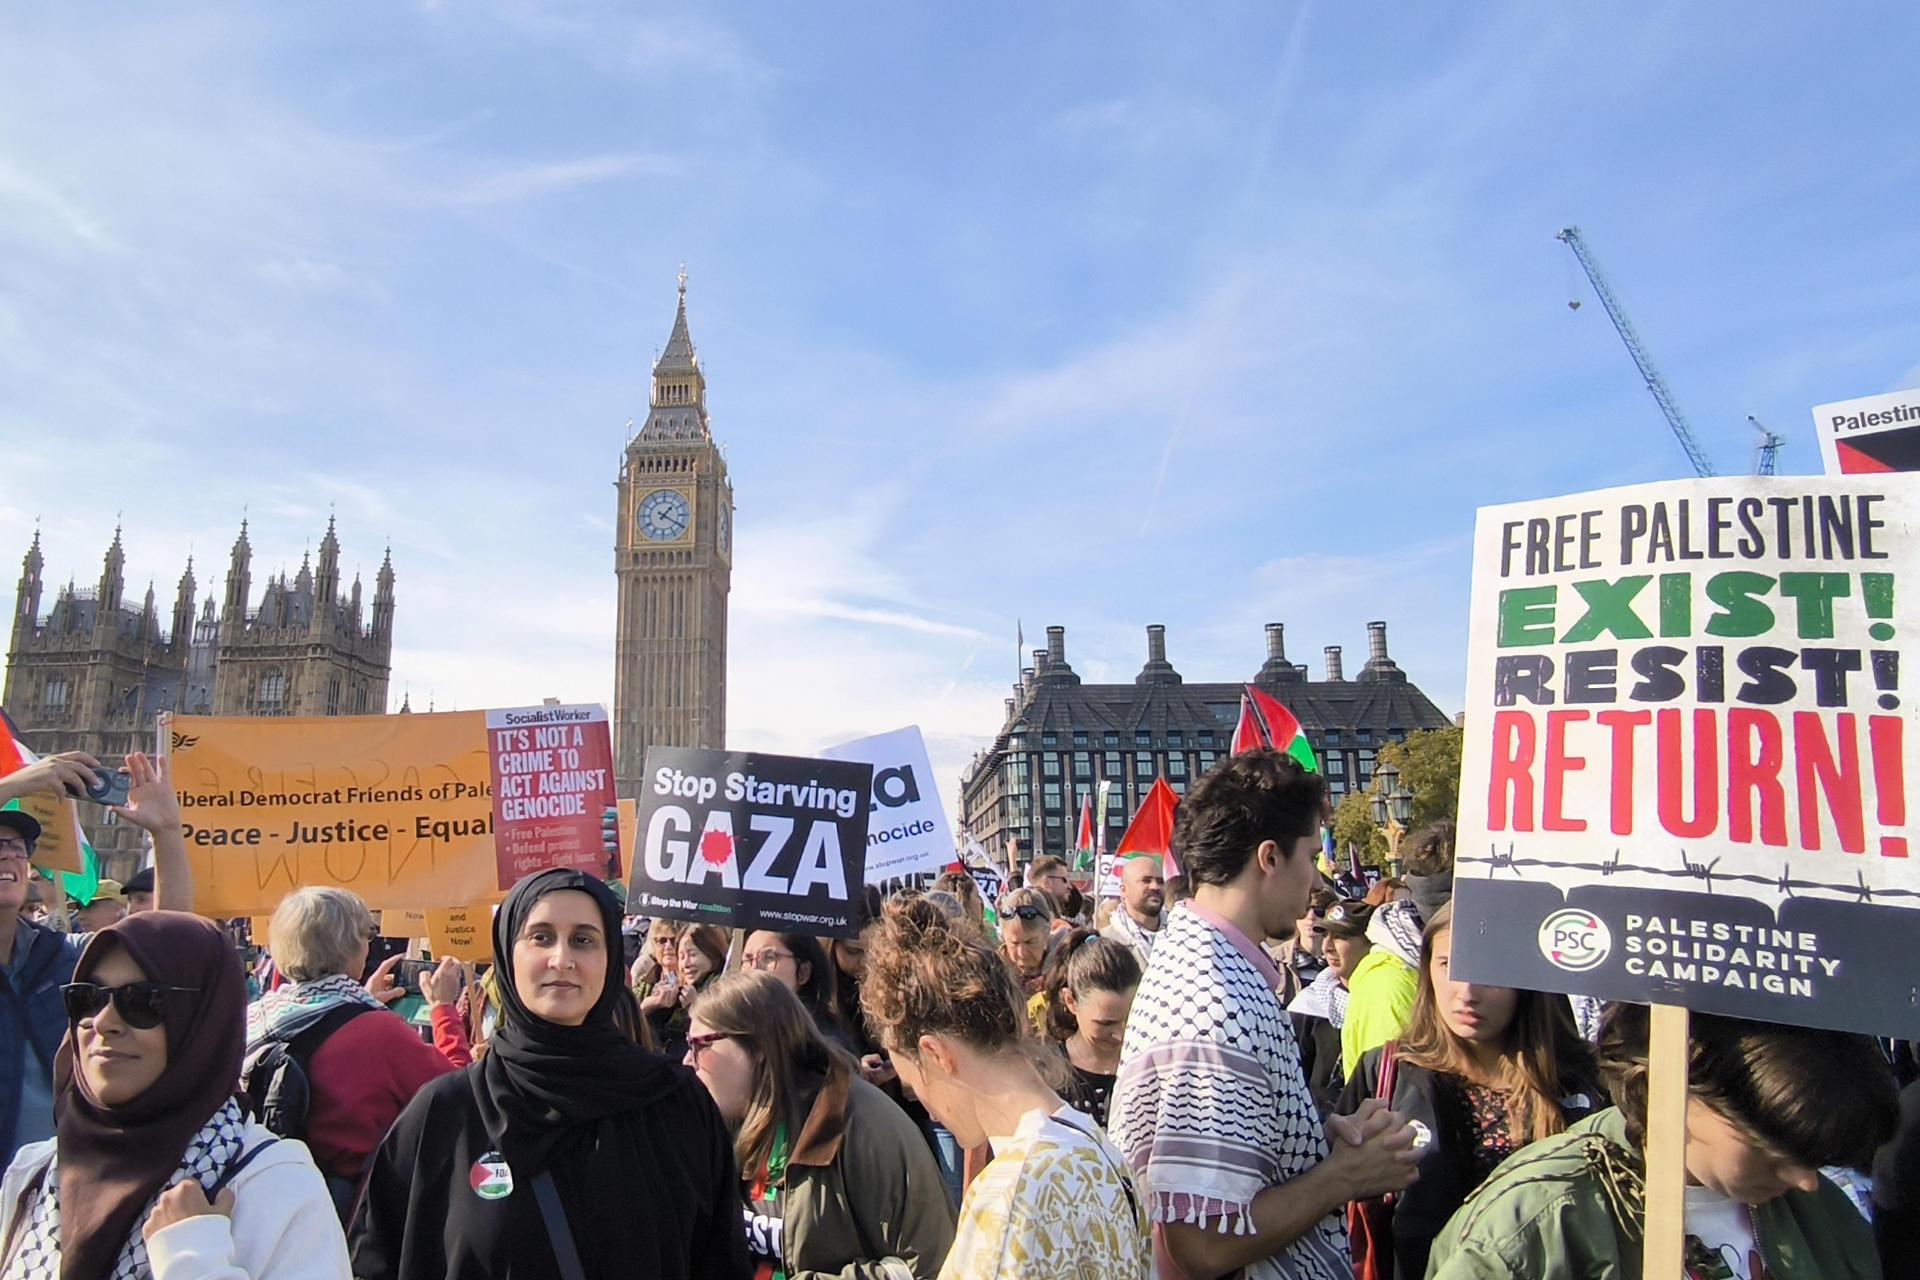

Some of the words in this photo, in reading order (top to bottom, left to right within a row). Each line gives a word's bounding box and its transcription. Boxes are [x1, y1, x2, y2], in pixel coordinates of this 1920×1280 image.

[1831, 404, 1920, 433] Palestin
[1500, 510, 1603, 577] FREE
[1620, 495, 1889, 566] PALESTINE
[1497, 571, 1896, 648] EXIST!
[1494, 645, 1901, 710] RESIST!
[496, 729, 529, 752] IT'S
[535, 726, 568, 750] NOT
[573, 725, 584, 747] A
[498, 749, 555, 775] CRIME
[558, 748, 579, 770] TO
[176, 789, 234, 808] iberal
[239, 787, 342, 807] Democrat
[347, 785, 423, 804] Friends
[429, 782, 450, 800] of
[455, 780, 493, 799] Pale
[500, 773, 533, 798] ACT
[538, 768, 606, 795] AGAINST
[653, 766, 717, 804] Stop
[725, 771, 857, 818] Starving
[869, 764, 921, 812] a
[1487, 707, 1909, 858] RETURN!
[502, 793, 587, 821] GENOCIDE
[285, 817, 389, 845] Justice
[415, 811, 495, 843] Equal
[866, 819, 935, 847] nocide
[643, 804, 849, 901] GAZA
[444, 925, 476, 934] Justice
[449, 913, 467, 921] and
[759, 909, 848, 927] www.stopwar.org.uk
[1626, 914, 1817, 952] PALESTINE
[1554, 928, 1596, 952] PSC
[1625, 936, 1842, 977] SOLIDARITY
[1625, 957, 1813, 998] CAMPAIGN
